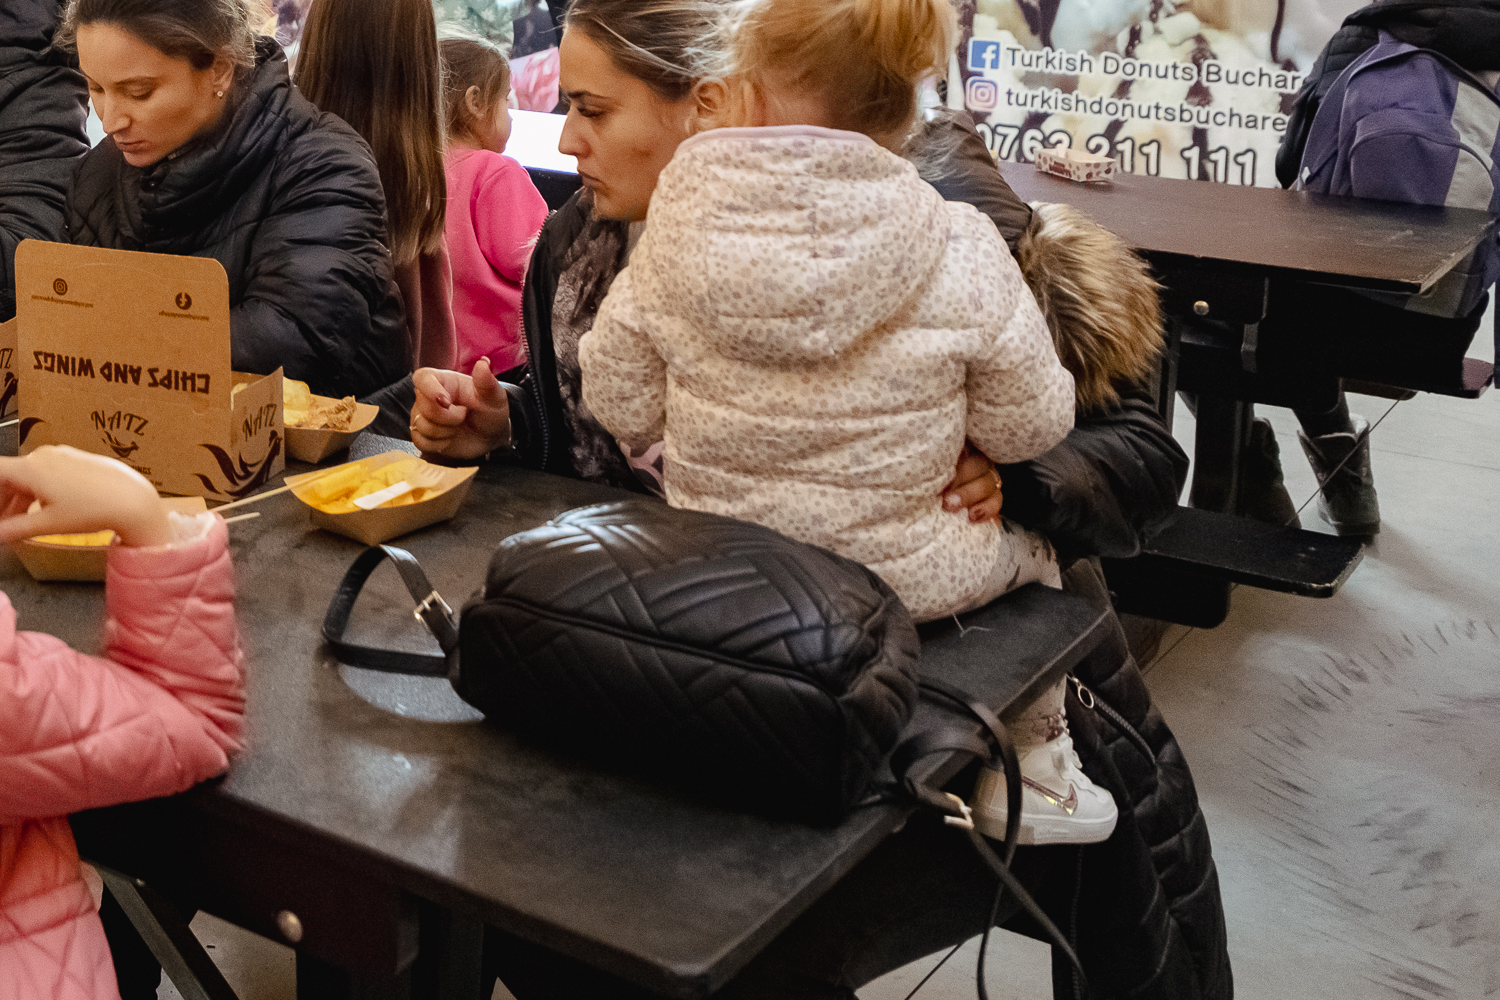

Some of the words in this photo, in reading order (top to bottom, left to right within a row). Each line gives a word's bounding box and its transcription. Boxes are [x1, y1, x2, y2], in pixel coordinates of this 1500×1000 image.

[1006, 47, 1093, 74] Turkish
[1103, 55, 1193, 81] Donuts
[1086, 133, 1160, 176] 211
[1180, 144, 1257, 188] 111
[33, 351, 96, 379] WINGS
[99, 361, 142, 385] AND
[147, 367, 211, 394] CHIPS
[91, 410, 149, 436] NATZ
[242, 403, 278, 441] NATZ
